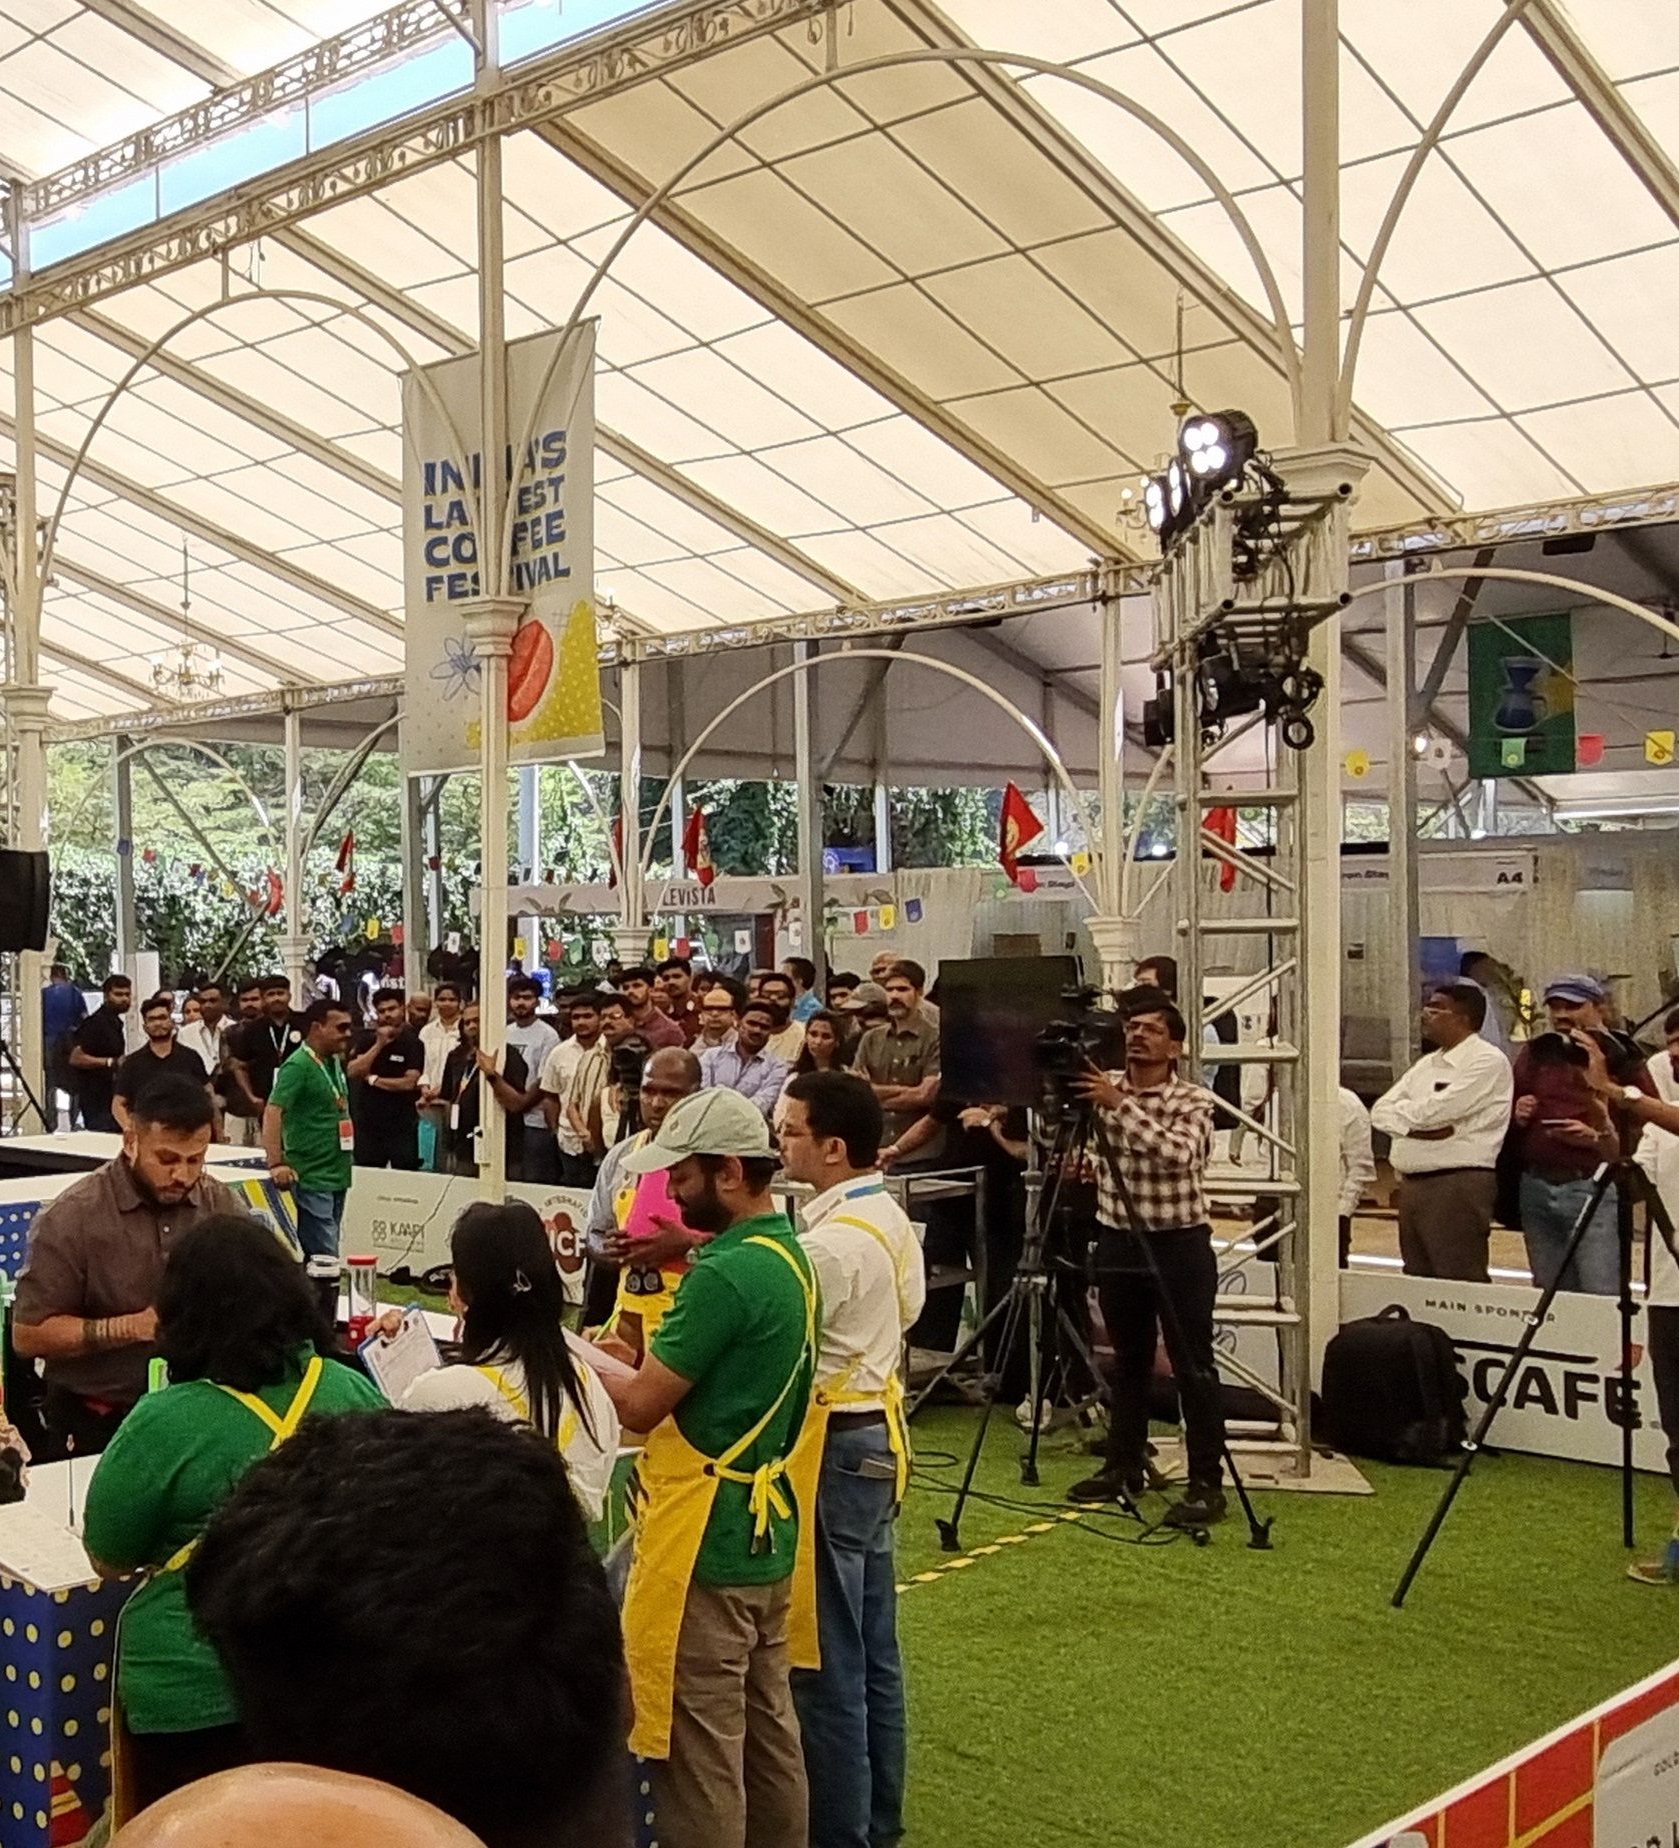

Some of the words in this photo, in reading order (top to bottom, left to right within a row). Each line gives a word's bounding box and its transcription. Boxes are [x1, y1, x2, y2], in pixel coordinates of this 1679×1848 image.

[423, 430, 567, 498] INIA'S
[423, 473, 565, 531] LAEST
[424, 509, 567, 568] COFEE
[425, 551, 571, 602] FESIVAL
[1424, 1299, 1467, 1312] MAIN
[1474, 1304, 1556, 1323] SPONR
